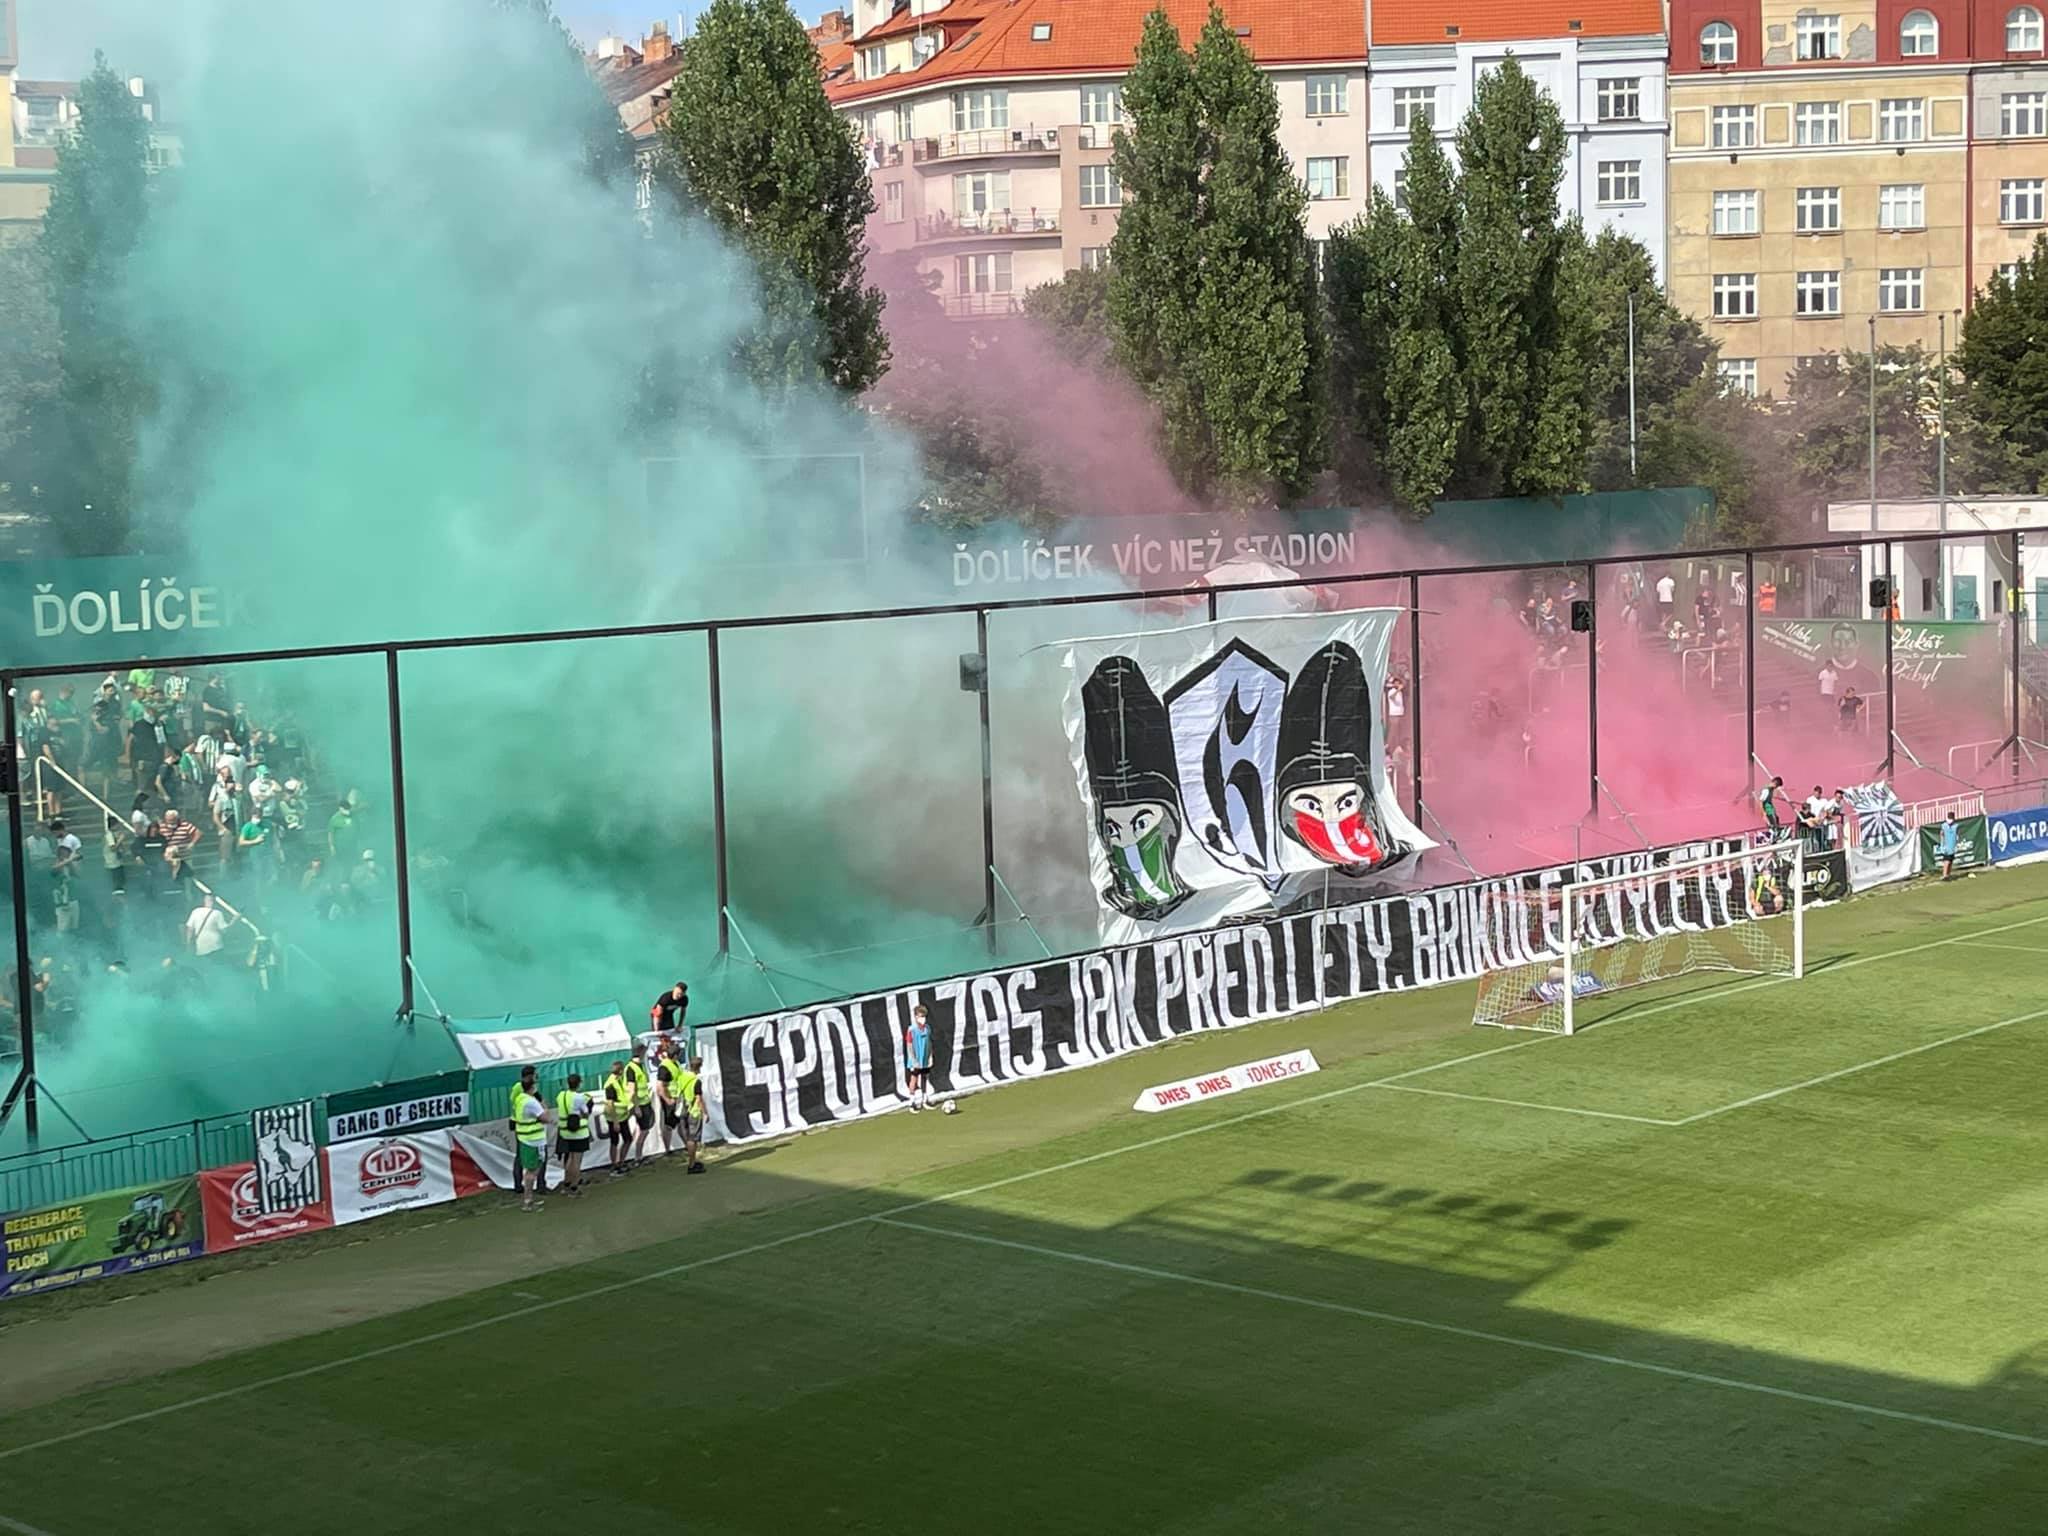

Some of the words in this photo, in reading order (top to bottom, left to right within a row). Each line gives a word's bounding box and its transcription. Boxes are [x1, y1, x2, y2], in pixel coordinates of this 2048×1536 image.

[953, 538, 1095, 586] ĎOLÍČEK
[1112, 534, 1162, 575] VÍC
[1170, 530, 1223, 572] NEŽ
[1233, 532, 1355, 567] STADION
[741, 990, 935, 1134] SPOLU
[935, 970, 1046, 1090] ZAS
[1057, 948, 1154, 1065] JAK
[1196, 1075, 1233, 1095] DNES
[336, 1111, 381, 1138] GANG
[385, 1105, 403, 1128] OF
[408, 1096, 462, 1120] GREENS
[361, 1171, 422, 1189] CENTRUM
[4, 1206, 83, 1234] REGENERACE
[7, 1250, 49, 1273] PLOCH
